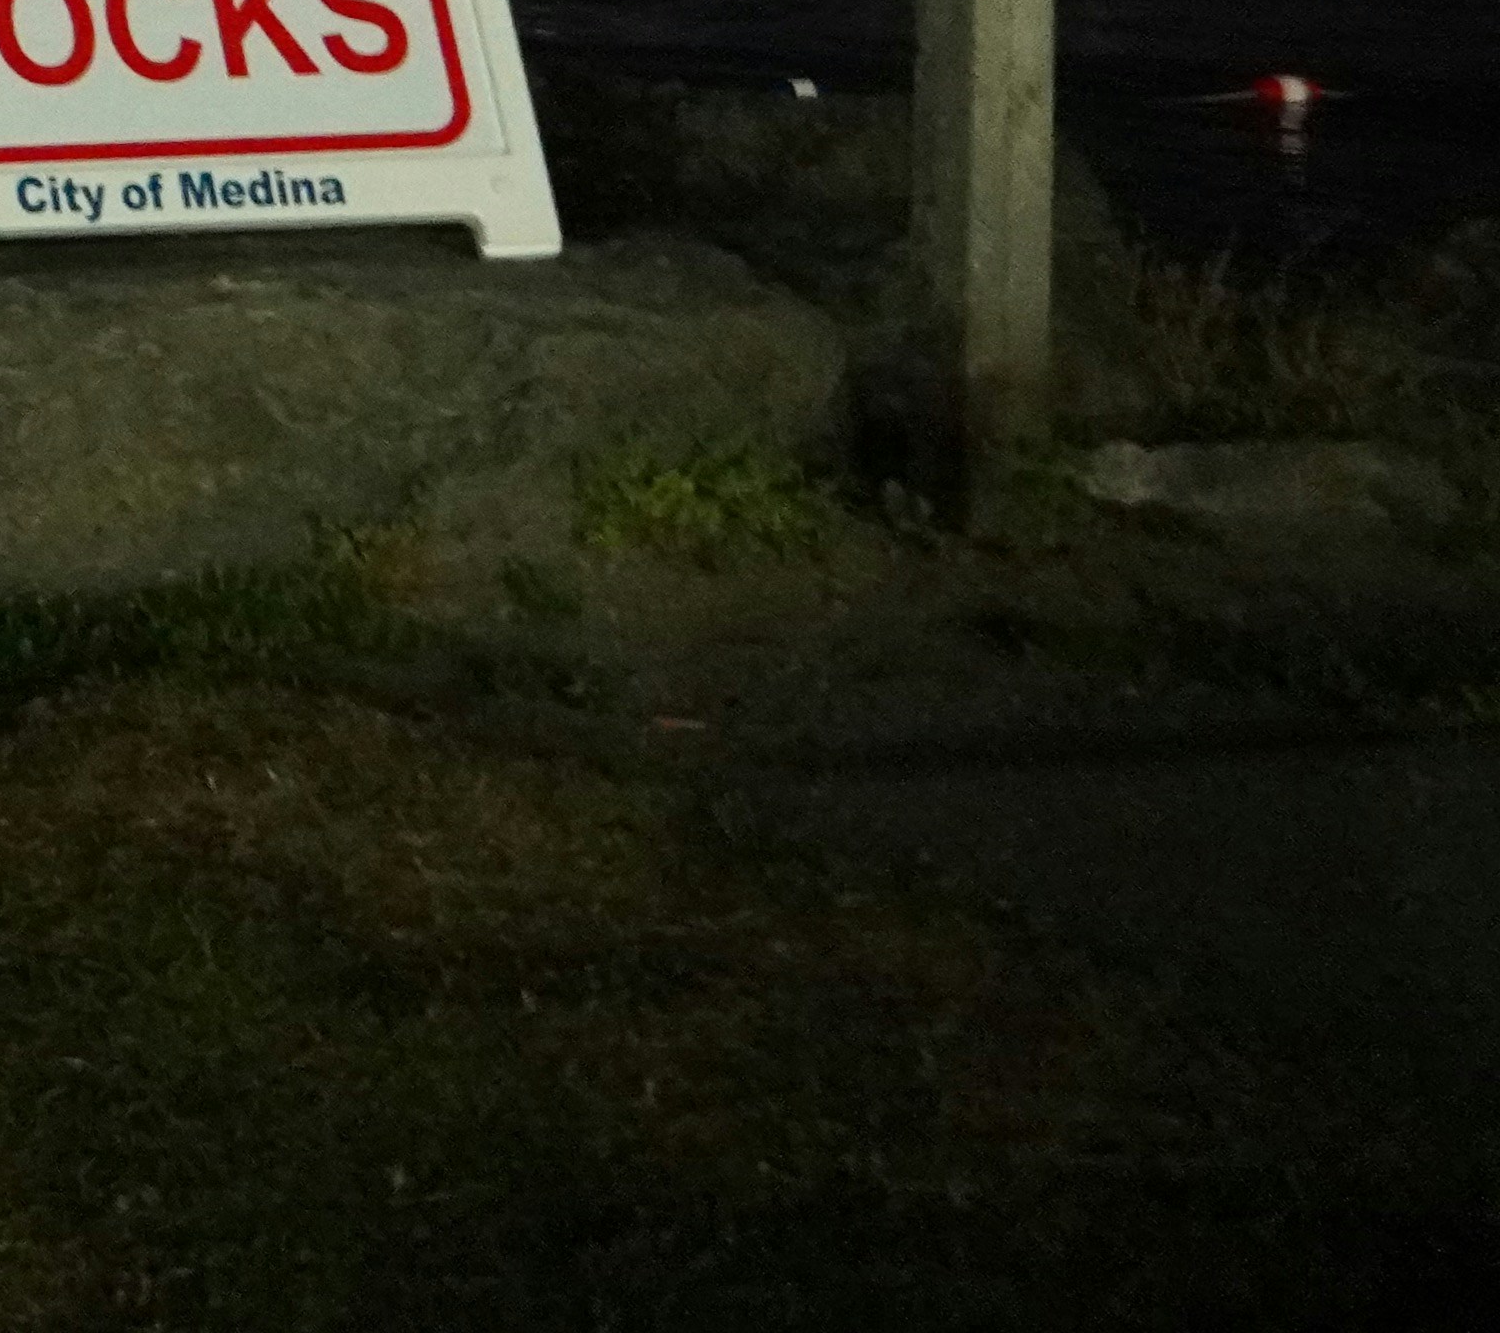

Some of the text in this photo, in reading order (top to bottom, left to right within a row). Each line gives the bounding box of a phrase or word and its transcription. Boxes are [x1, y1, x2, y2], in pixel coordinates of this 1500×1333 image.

[16, 170, 346, 224] City of Medina
